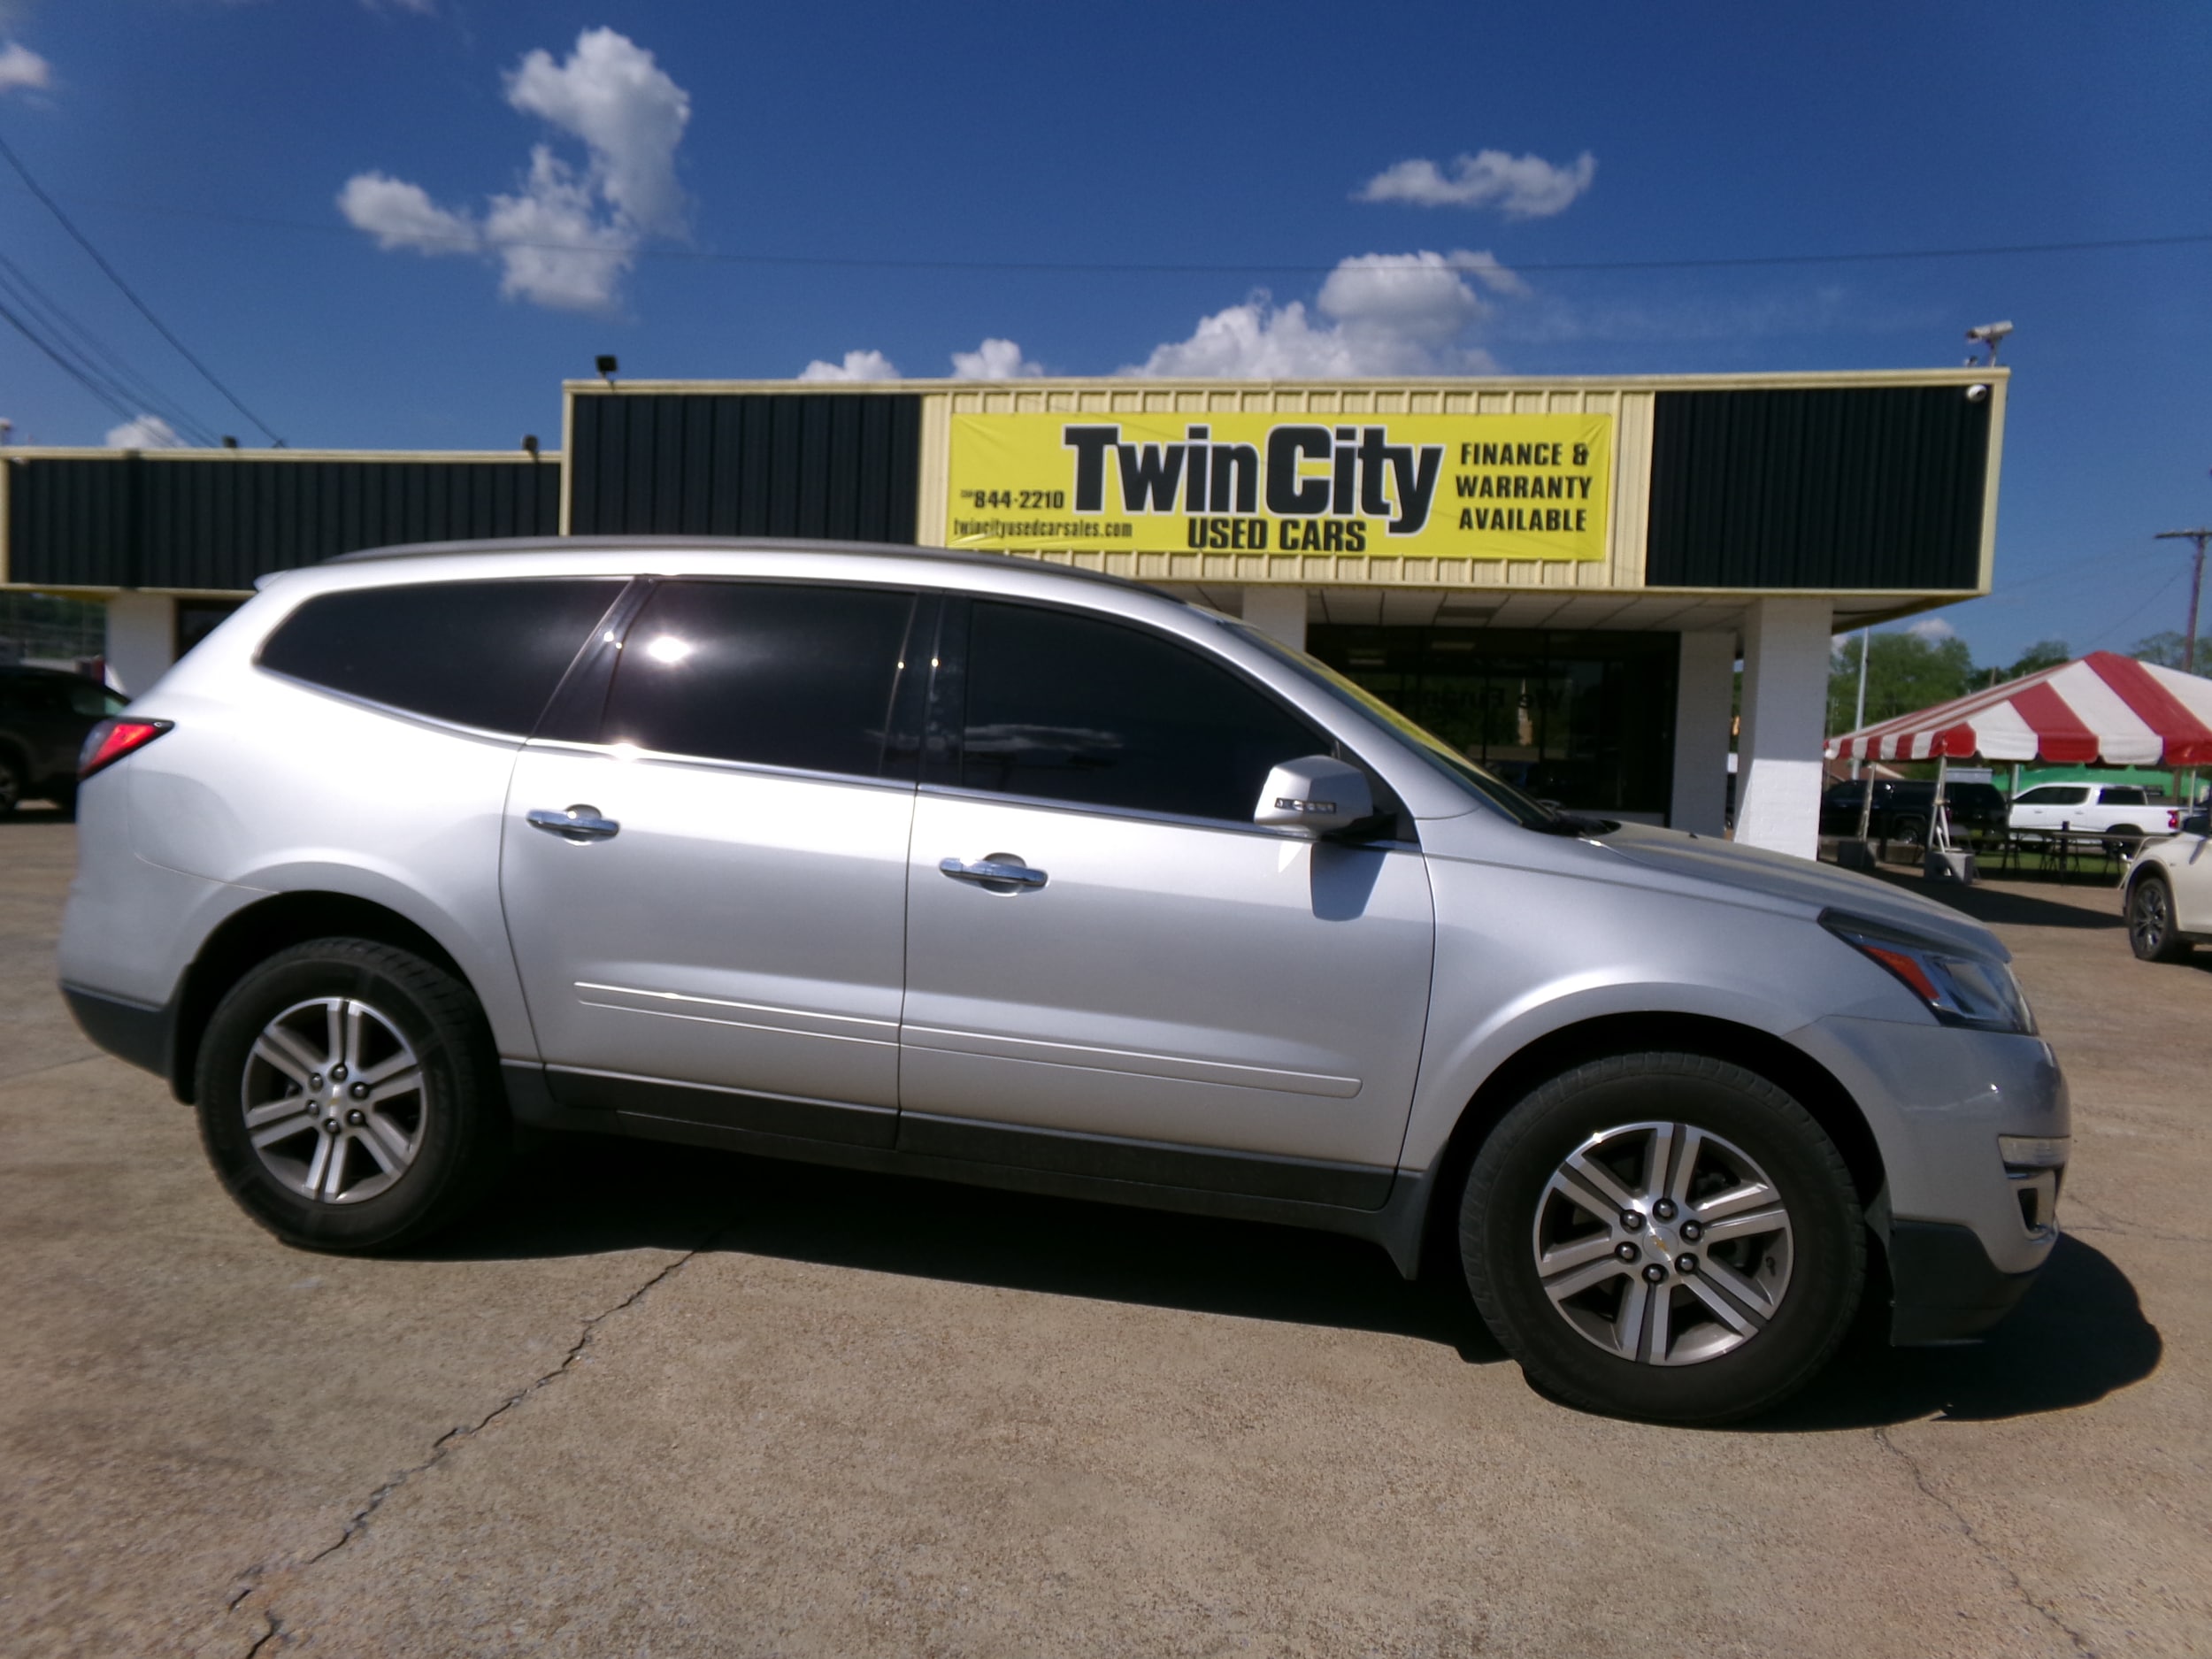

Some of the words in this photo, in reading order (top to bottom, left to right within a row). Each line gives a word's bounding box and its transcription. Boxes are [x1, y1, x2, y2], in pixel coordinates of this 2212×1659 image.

[1460, 442, 1563, 465] FINANCE
[1571, 442, 1589, 466] &
[1455, 474, 1592, 499] WARRANTY
[953, 518, 1133, 539] twincityusedcarsales.com
[1458, 507, 1587, 532] AVAILABLE
[1187, 517, 1269, 549] USED
[1279, 519, 1366, 553] CARS
